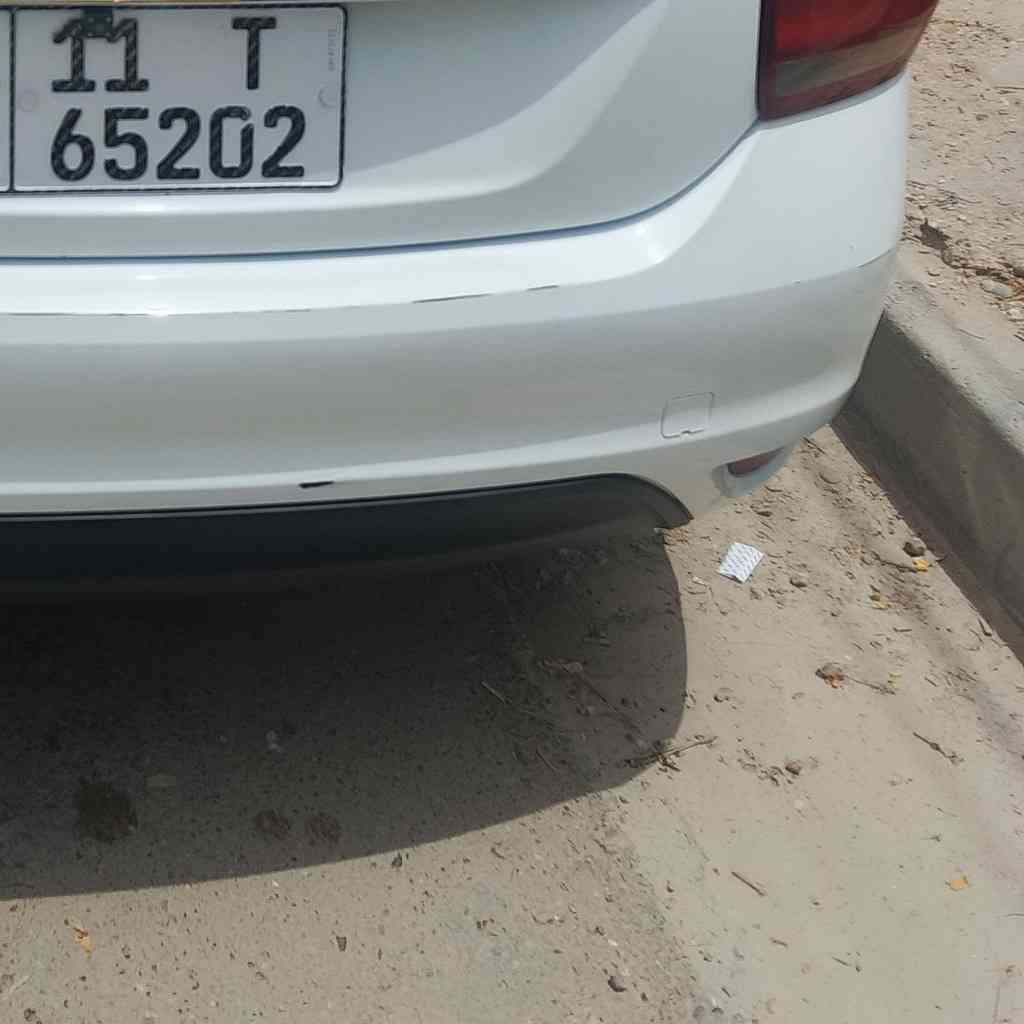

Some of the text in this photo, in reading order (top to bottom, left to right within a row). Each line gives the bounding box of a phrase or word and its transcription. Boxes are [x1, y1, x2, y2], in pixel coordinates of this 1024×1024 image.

[51, 16, 150, 93] 11
[231, 16, 278, 91] T
[50, 104, 307, 182] 65202
